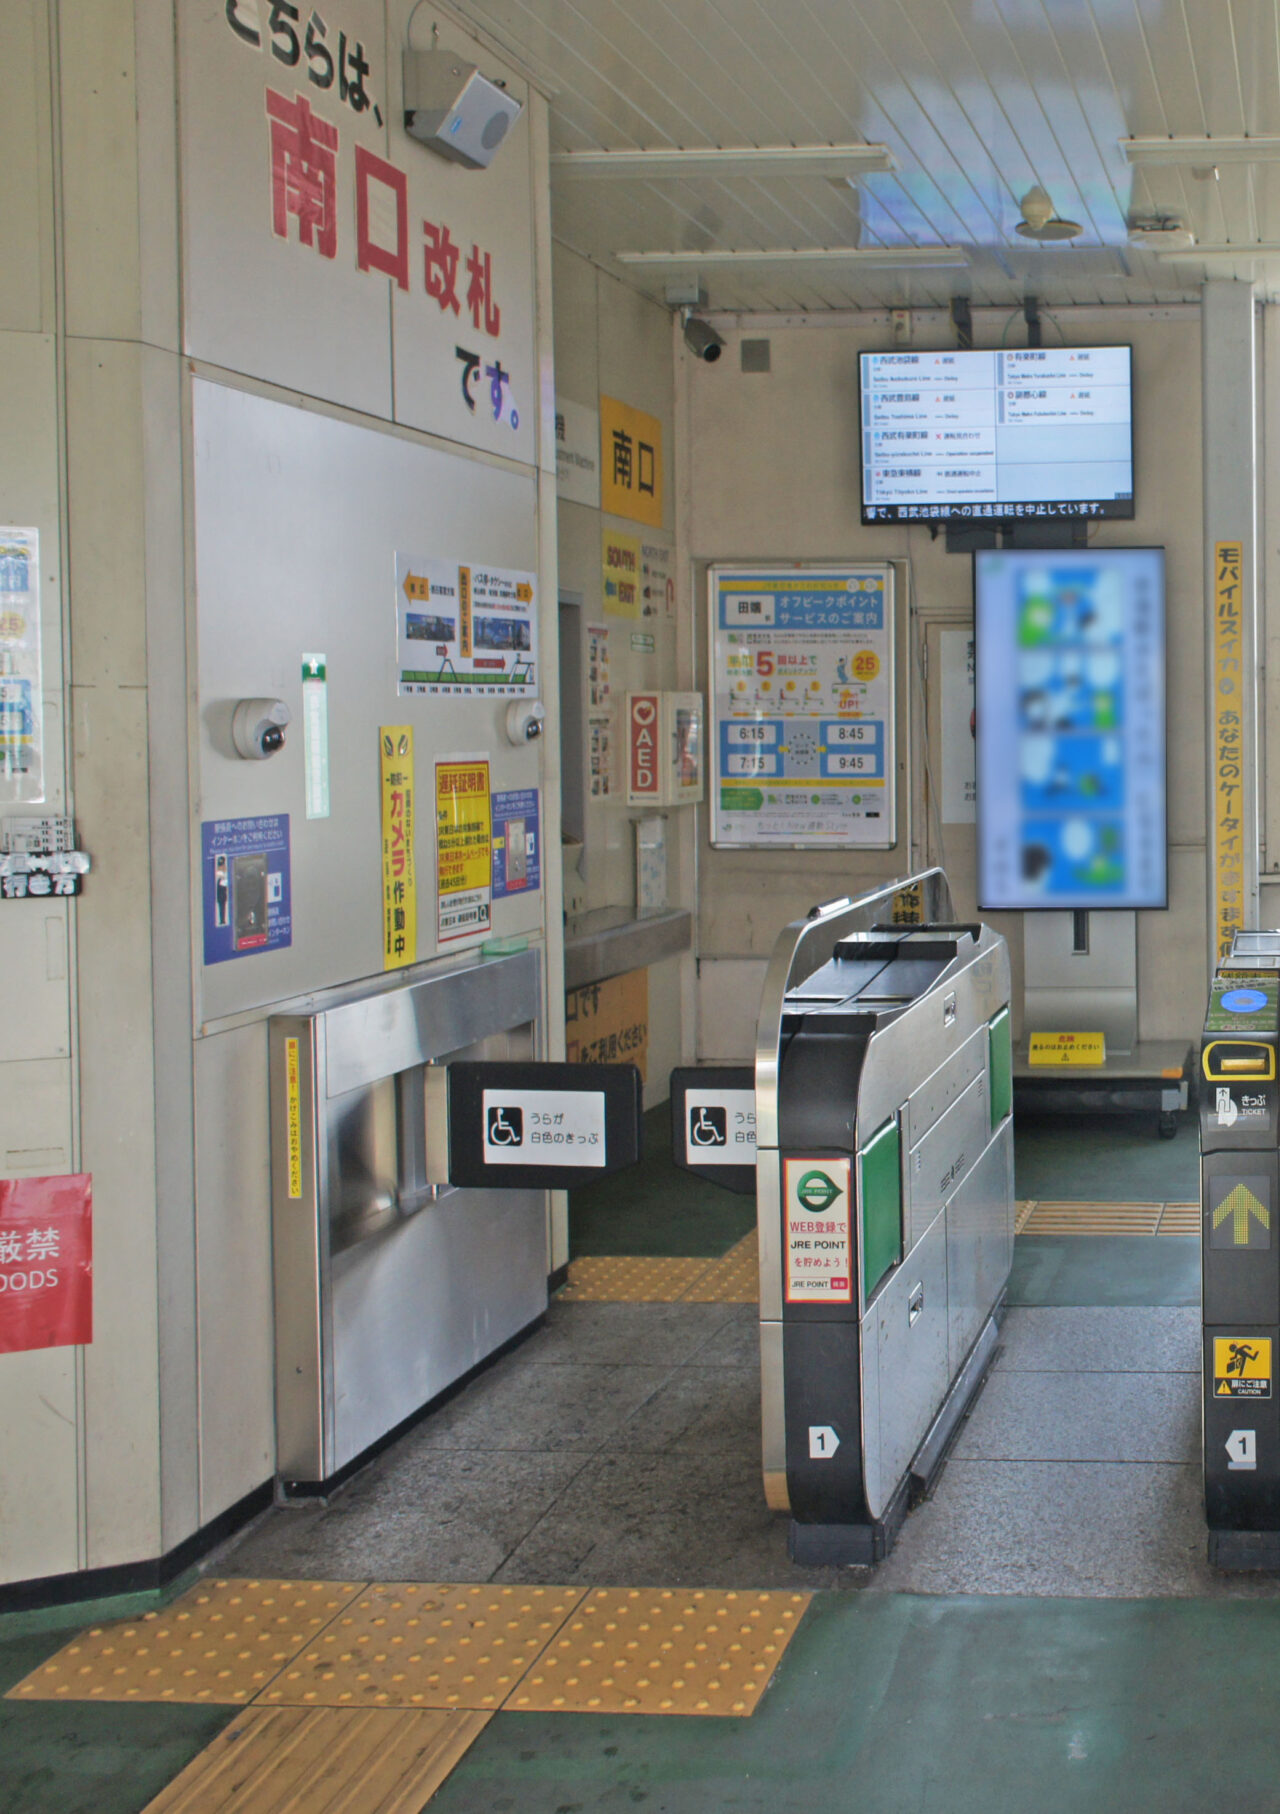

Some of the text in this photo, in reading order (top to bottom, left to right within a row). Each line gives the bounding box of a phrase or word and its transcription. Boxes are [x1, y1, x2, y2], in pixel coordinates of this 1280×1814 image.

[226, 0, 384, 129] こちらは、
[265, 87, 500, 338] 南口改札
[455, 344, 519, 431] です。
[612, 428, 655, 498] 南口
[738, 601, 762, 614] 田端
[780, 596, 878, 609] オフピークポイント
[780, 613, 878, 625] サービスのご案内
[756, 651, 775, 677] 5
[855, 657, 875, 671] 25
[739, 728, 765, 740] 6:15
[838, 728, 864, 740] 8:45
[636, 727, 653, 788] AED
[740, 757, 765, 769] 7:15
[839, 757, 864, 769] 9:45
[439, 772, 485, 794] 遅延証明書
[390, 790, 405, 958] カメラ作動中
[1241, 1094, 1266, 1107] きっぷ
[530, 1112, 564, 1126] うらが
[530, 1131, 599, 1145] 白色のきっぷ
[790, 1221, 847, 1234] WEB登録で
[790, 1240, 846, 1249] JRE POINT
[1231, 1380, 1267, 1388] 扉にご注意
[817, 1433, 826, 1451] 1
[1238, 1437, 1247, 1454] 1
